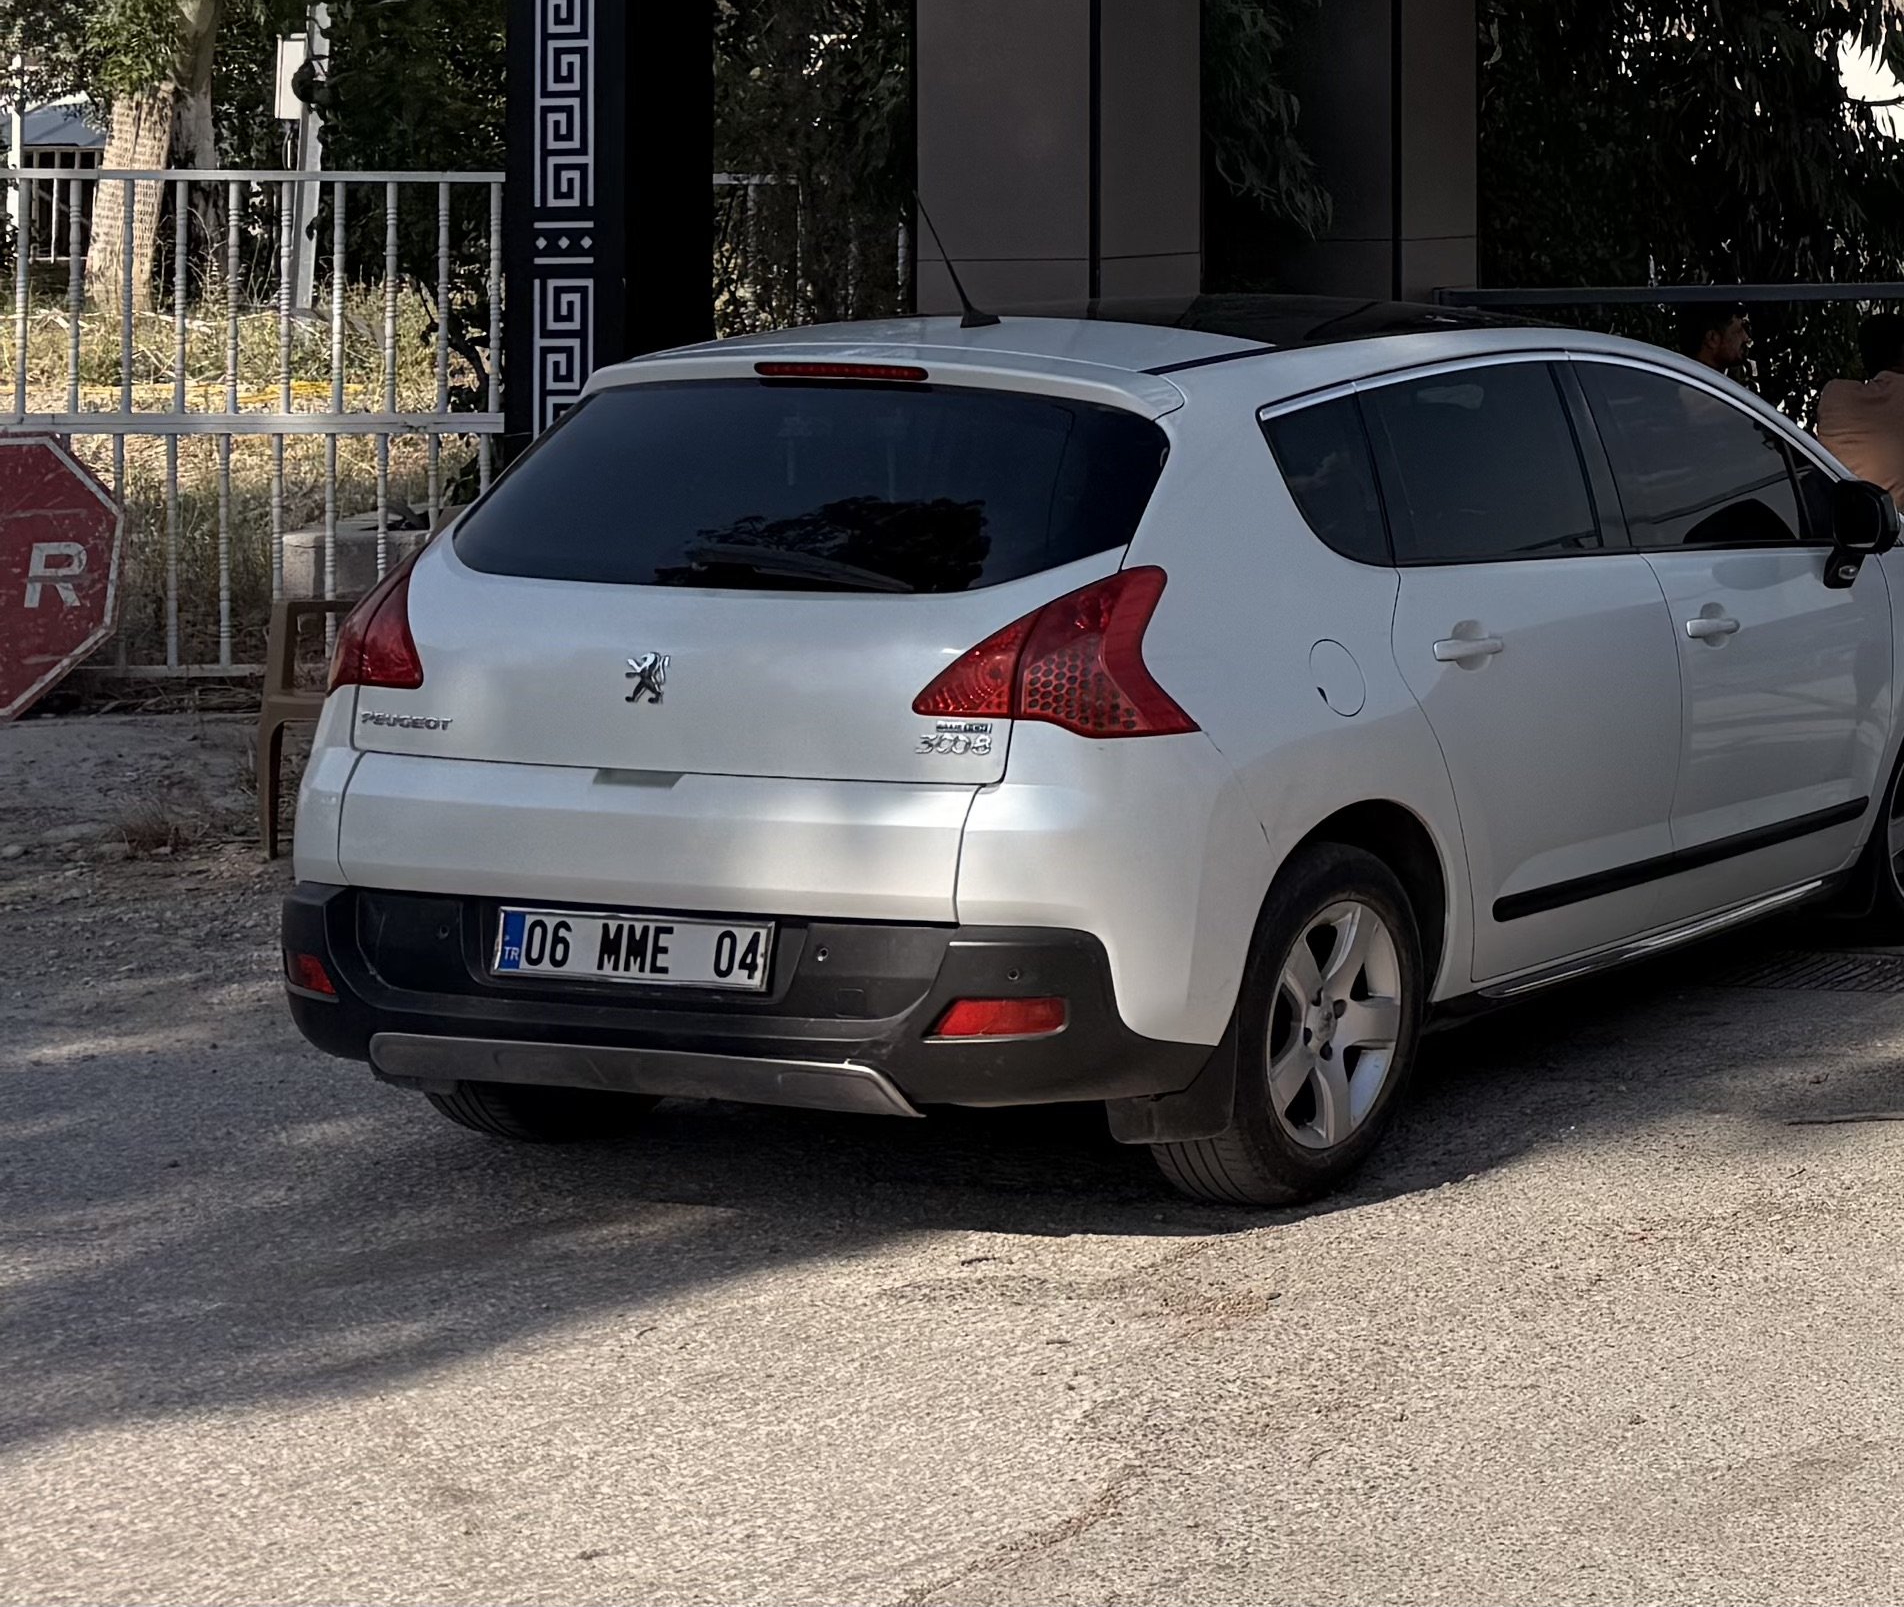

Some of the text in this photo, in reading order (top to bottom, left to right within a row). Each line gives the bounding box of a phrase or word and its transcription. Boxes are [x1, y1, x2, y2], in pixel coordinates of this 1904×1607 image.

[24, 541, 88, 608] R
[361, 711, 453, 731] PEUGEOT
[503, 946, 520, 961] TR
[524, 919, 762, 981] 06 MME 04
